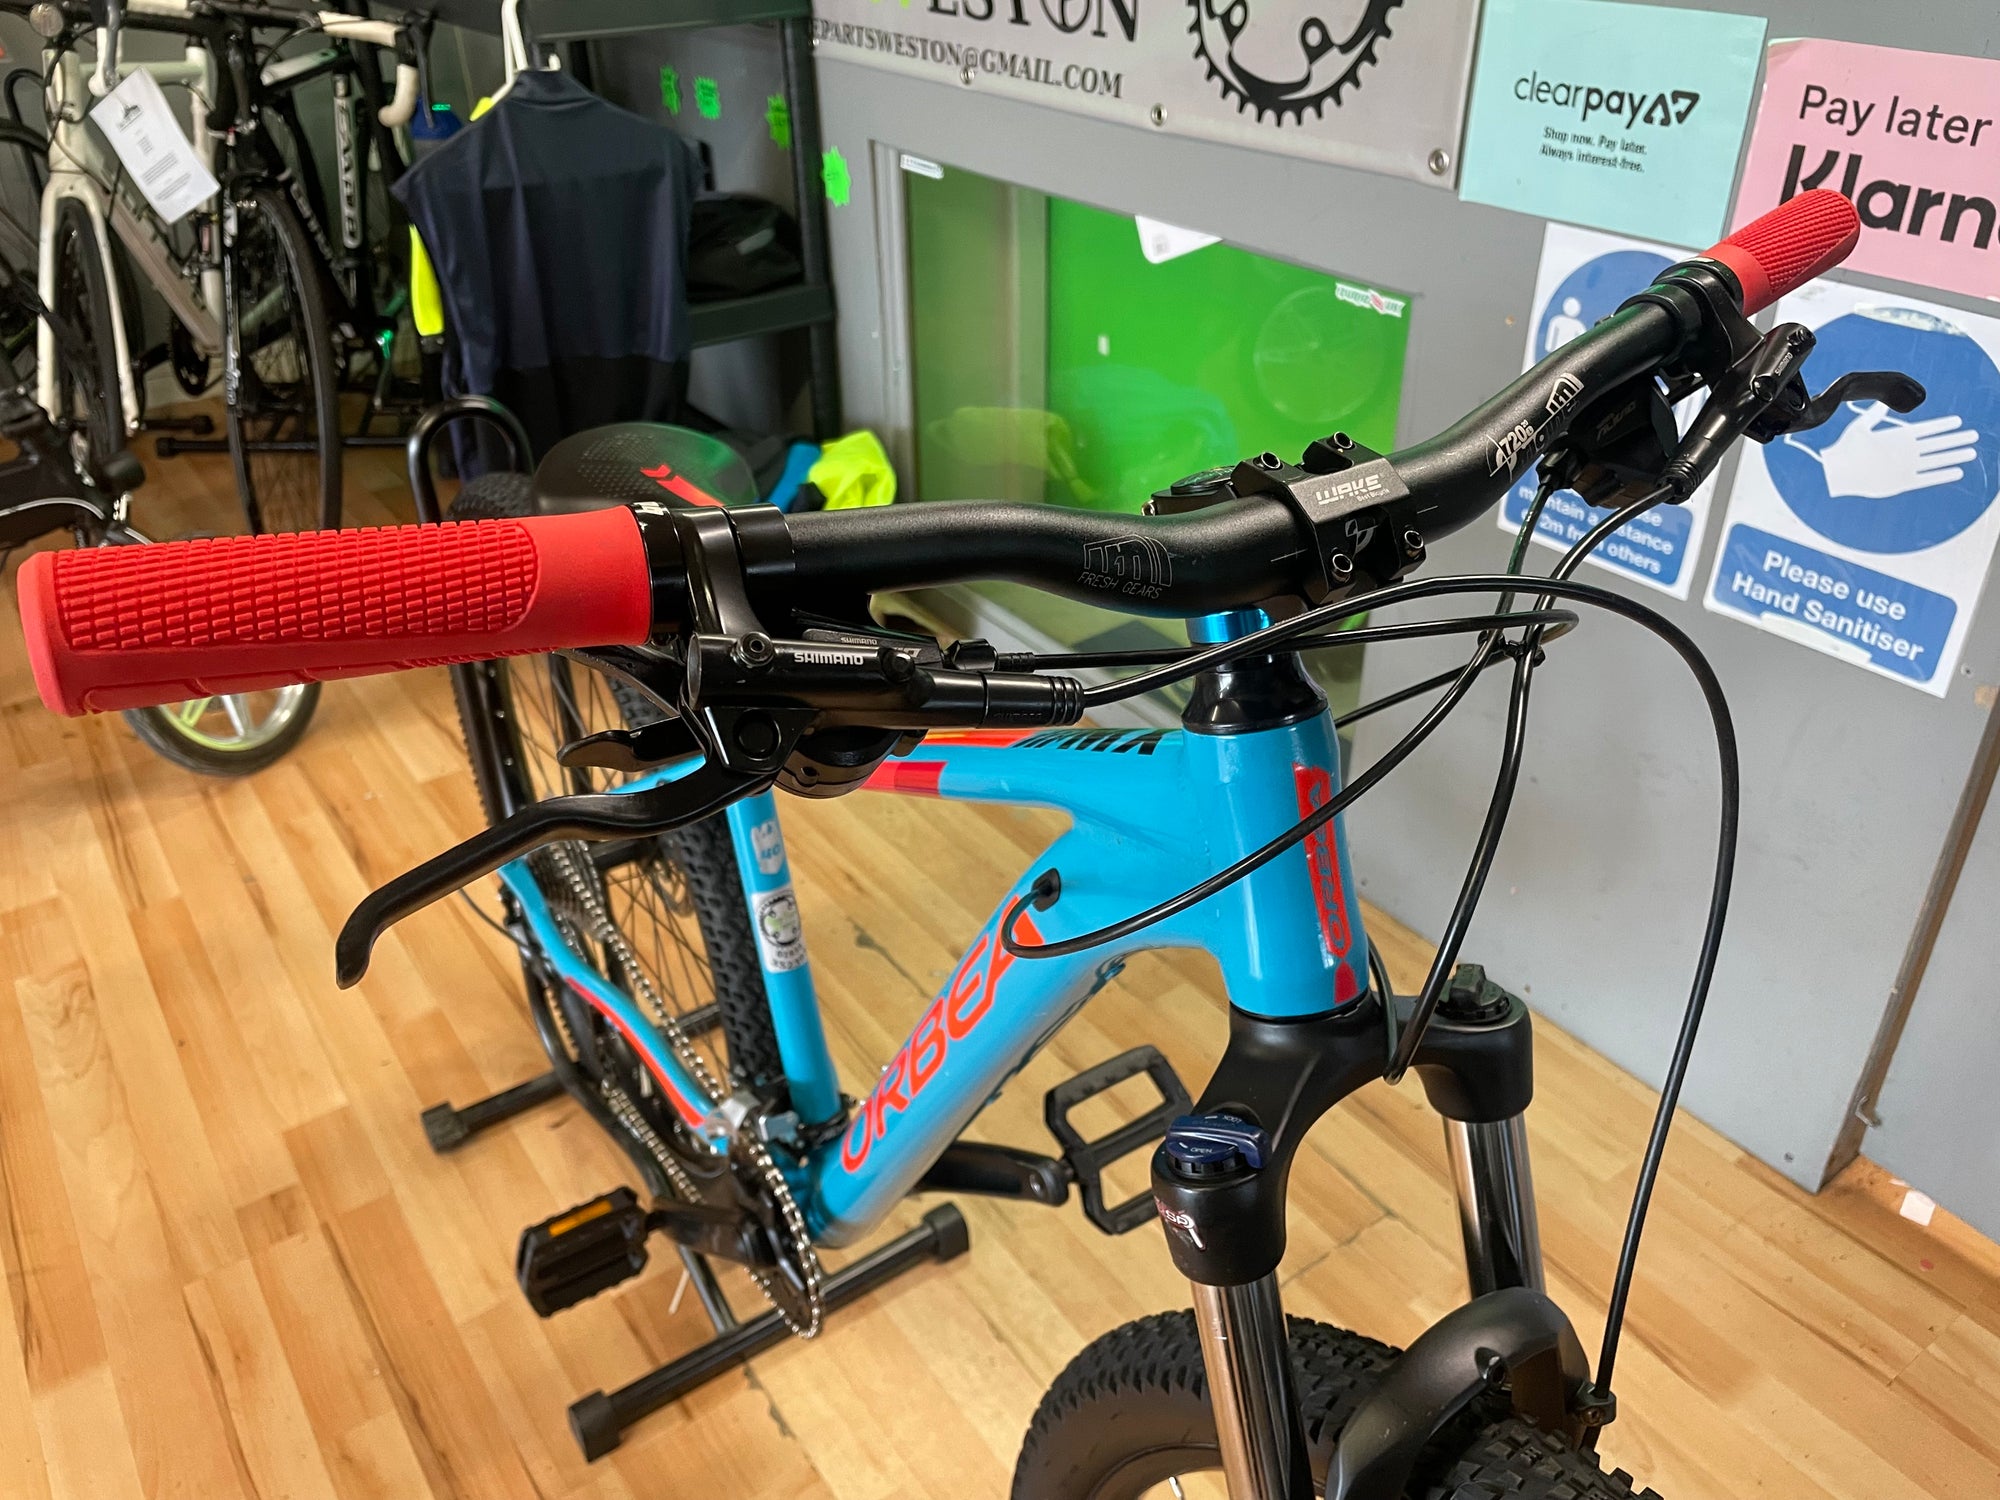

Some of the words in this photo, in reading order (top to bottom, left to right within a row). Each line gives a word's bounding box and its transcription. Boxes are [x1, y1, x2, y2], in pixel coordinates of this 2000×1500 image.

[1514, 70, 1647, 129] clearpay
[1799, 84, 1876, 137] Pay
[1885, 95, 1993, 147] later
[1540, 143, 1574, 161] Always
[1543, 126, 1568, 143] Shop
[1599, 134, 1618, 152] Pay
[1779, 143, 2000, 250] Klarn
[1518, 486, 1585, 521] mntain
[1607, 542, 1661, 574] others
[1077, 571, 1120, 589] FRESH
[1122, 581, 1163, 600] GEARS
[1763, 550, 1850, 600] Please
[1855, 589, 1907, 621] use
[1731, 570, 1800, 615] Hand
[1803, 599, 1925, 662] Sanitiser
[794, 652, 864, 666] SHIMANO
[840, 637, 877, 646] SHIMANO
[841, 895, 1046, 1173] ORBEA
